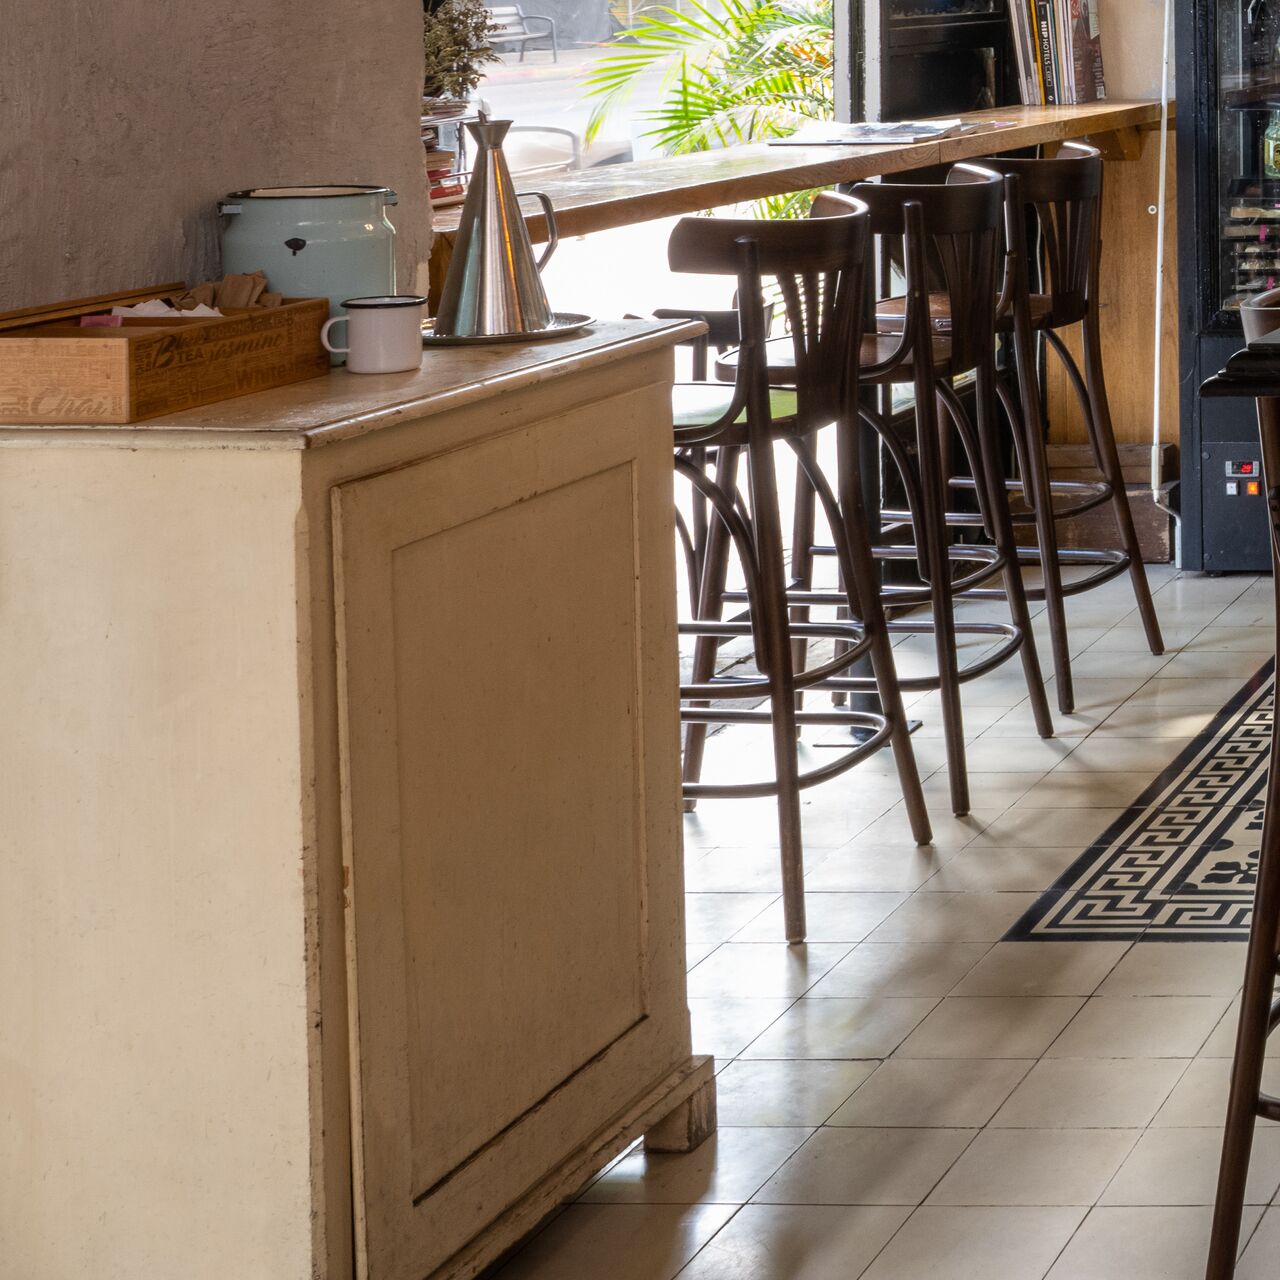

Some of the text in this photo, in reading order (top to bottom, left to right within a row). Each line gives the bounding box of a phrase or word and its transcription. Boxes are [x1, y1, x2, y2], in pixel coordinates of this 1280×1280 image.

[1040, 20, 1051, 65] HIP HOTELS
[178, 351, 204, 364] TEA
